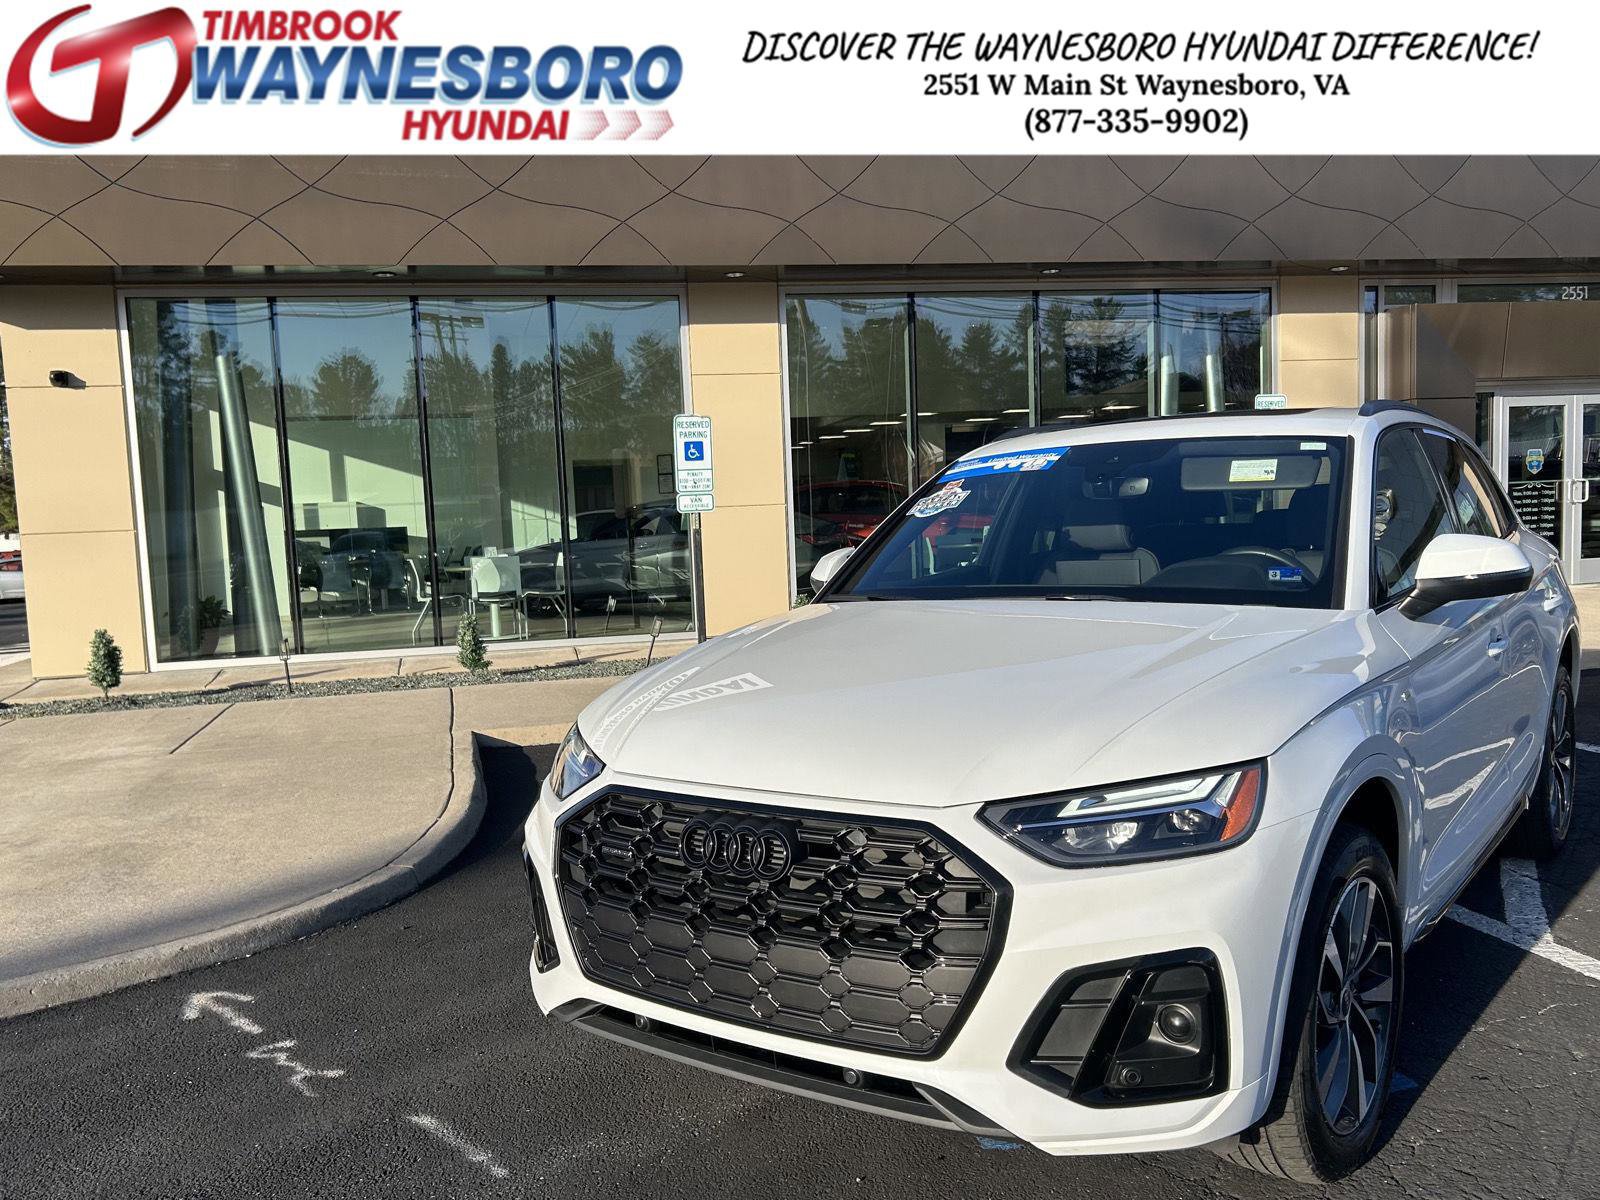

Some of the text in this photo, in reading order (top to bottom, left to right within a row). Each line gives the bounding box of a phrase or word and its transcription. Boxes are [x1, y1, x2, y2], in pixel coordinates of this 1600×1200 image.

[1561, 286, 1589, 300] 2551
[677, 421, 709, 429] RESERVED
[680, 431, 707, 439] PARKING
